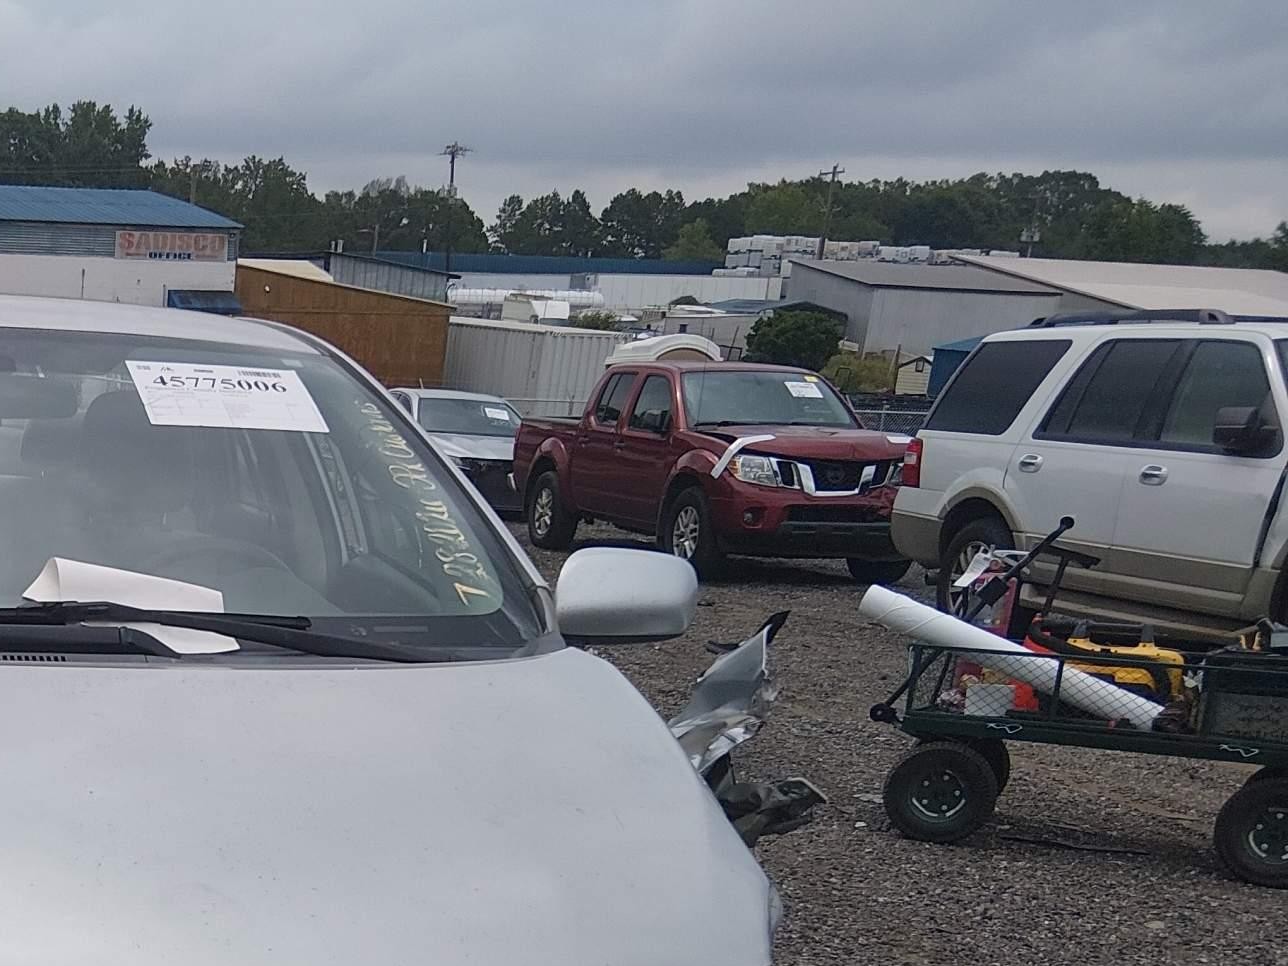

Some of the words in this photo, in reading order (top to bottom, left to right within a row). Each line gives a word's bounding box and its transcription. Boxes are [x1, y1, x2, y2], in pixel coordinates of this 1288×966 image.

[119, 232, 226, 252] SADISCO
[148, 251, 193, 261] OFFICE
[152, 375, 288, 393] 45775006
